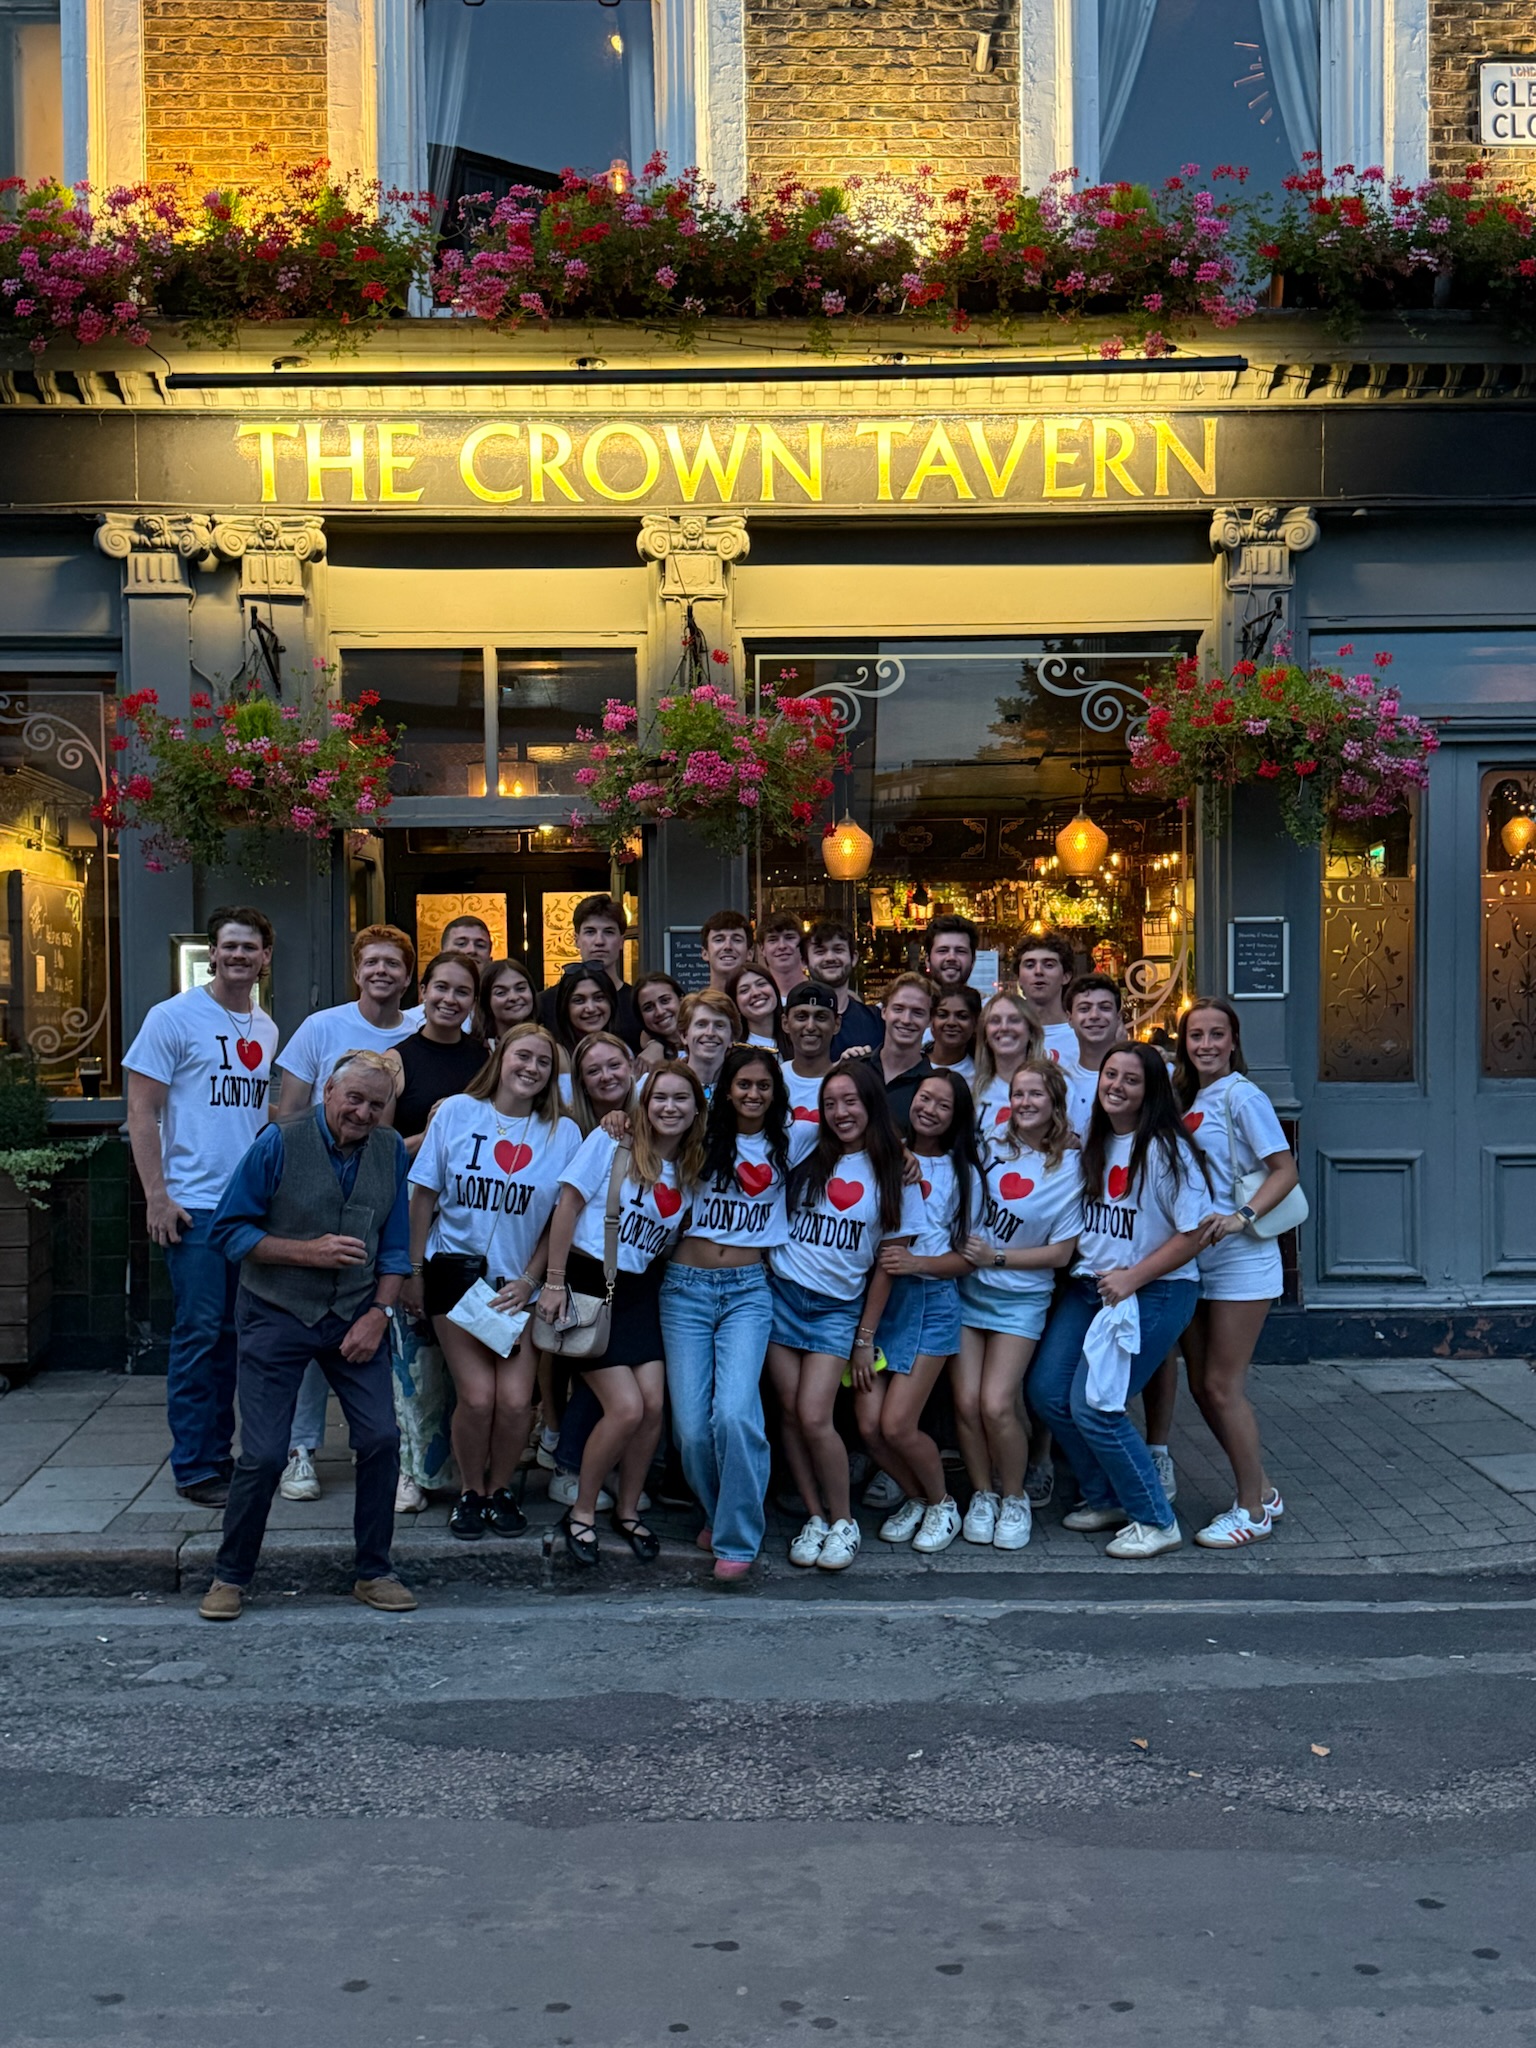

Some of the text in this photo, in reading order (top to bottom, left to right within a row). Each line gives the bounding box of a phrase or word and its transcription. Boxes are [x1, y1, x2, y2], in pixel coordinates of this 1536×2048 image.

[1492, 81, 1536, 107] CLE
[236, 417, 1219, 503] THE CROWN TAVERN
[215, 1035, 232, 1070] I
[465, 1133, 488, 1170] I
[455, 1174, 536, 1216] LONDON
[697, 1197, 774, 1233] LONDON
[789, 1210, 866, 1252] LONDON
